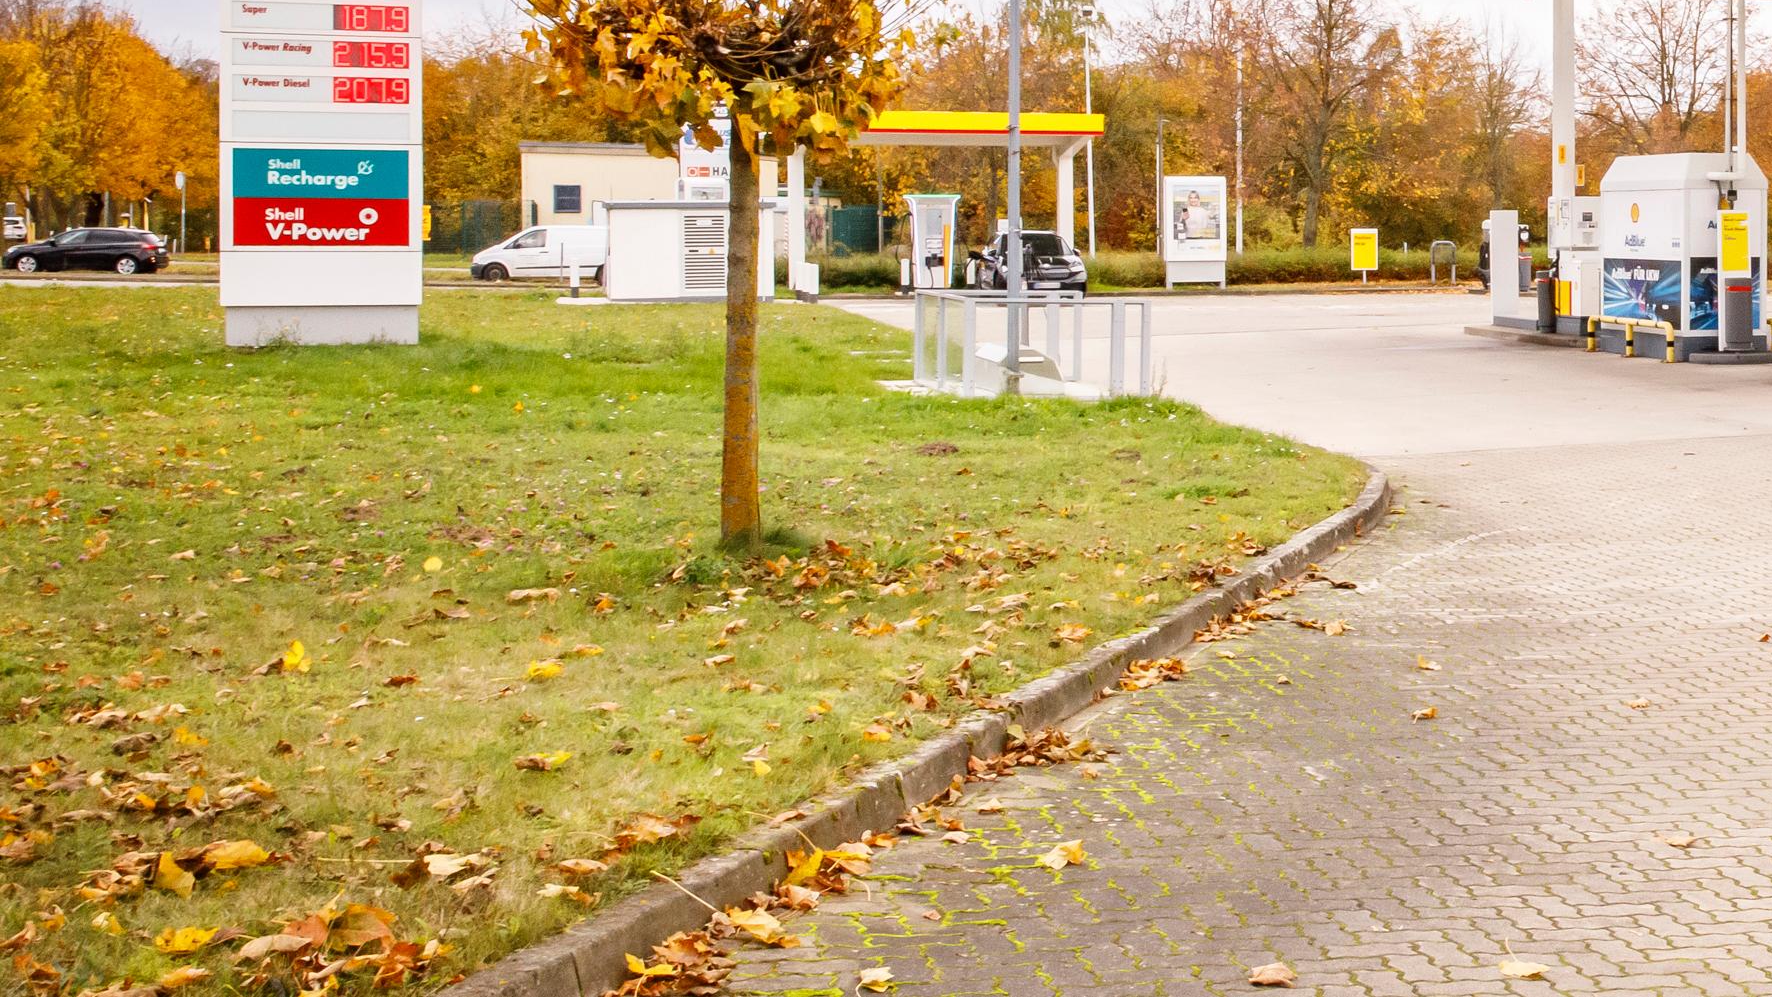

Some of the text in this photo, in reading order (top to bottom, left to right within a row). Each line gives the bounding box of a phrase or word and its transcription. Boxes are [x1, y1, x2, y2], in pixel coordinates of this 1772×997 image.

[242, 4, 267, 15] Super
[343, 6, 407, 31] 187.9
[242, 42, 312, 54] V-Power Racing
[334, 42, 407, 68] 215.9
[242, 78, 310, 88] V-Power Diesel
[334, 78, 407, 103] 207.9
[267, 158, 301, 170] Shell
[267, 170, 359, 189] Recharge
[265, 207, 304, 221] Shell
[265, 222, 370, 240] V-Power
